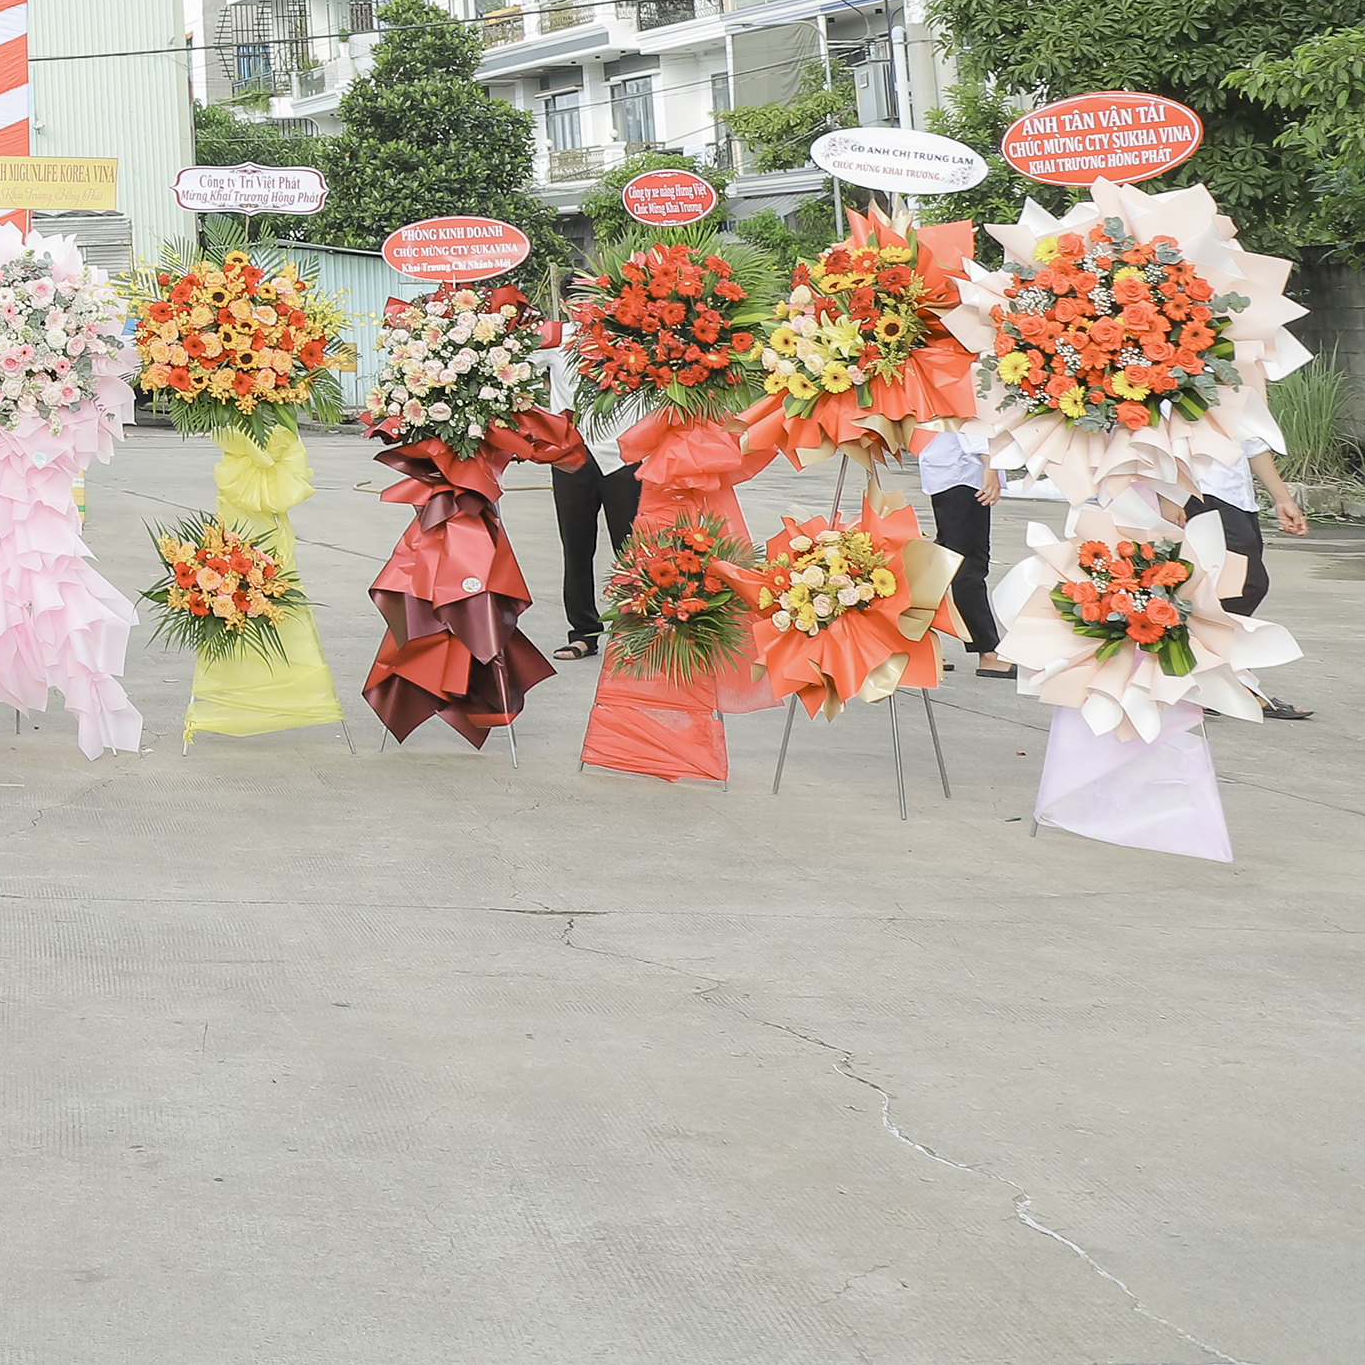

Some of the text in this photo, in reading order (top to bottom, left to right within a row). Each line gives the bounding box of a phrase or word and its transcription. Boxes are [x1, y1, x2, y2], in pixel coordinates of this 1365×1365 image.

[1021, 116, 1059, 136] ANH
[1060, 109, 1095, 132] TÂN
[1097, 105, 1133, 131] VẬN
[1008, 125, 1193, 159] CHÚC MỪNG CTY SUKHA VINA
[1028, 159, 1056, 175] KHAI
[1056, 153, 1106, 173] TRƯƠNG
[1140, 145, 1173, 165] PHÁT
[8, 163, 58, 183] MIGUNLIFE
[60, 164, 91, 183] KOREA
[92, 164, 116, 184] VINA
[199, 174, 301, 192] Công ty Trí Việt Phát
[401, 225, 504, 241] PHÒNG KINH DOANH
[392, 243, 518, 258] CHÚC MỪNG CTY SUKAVINA
